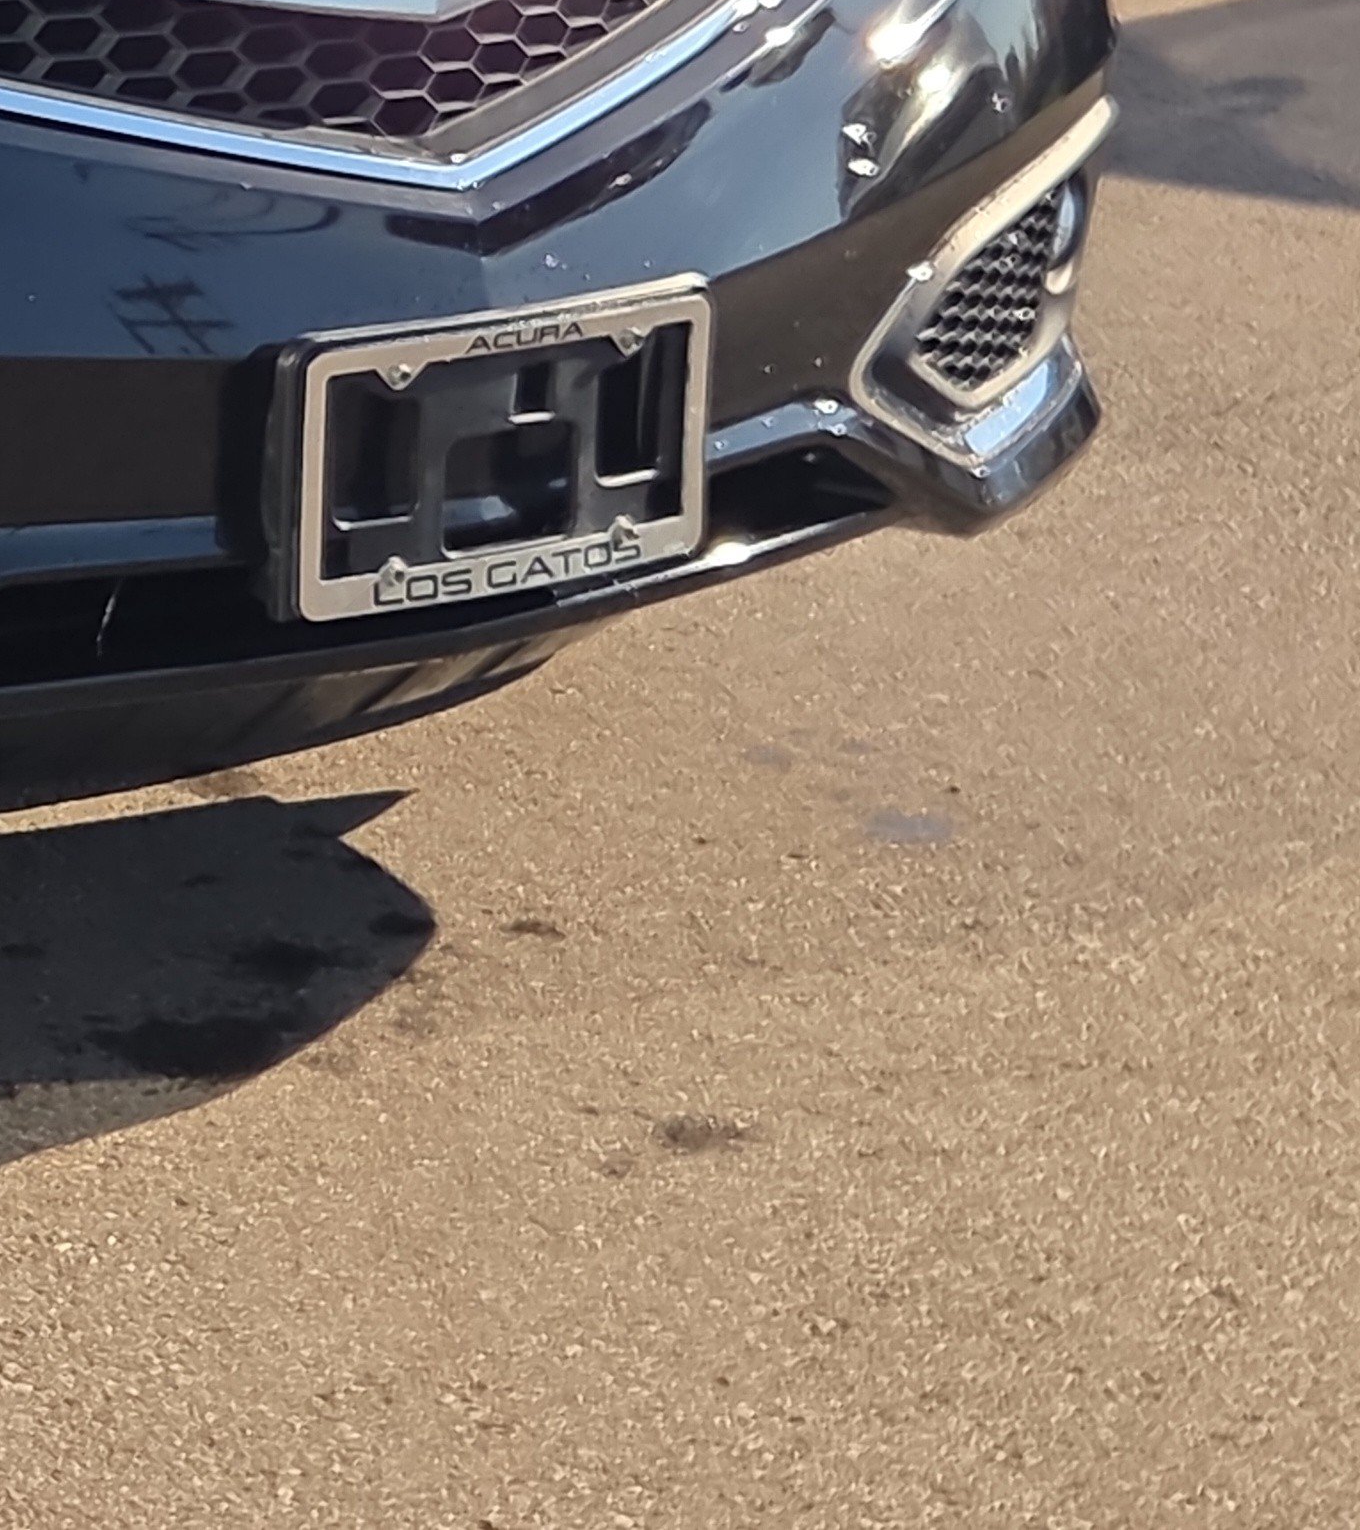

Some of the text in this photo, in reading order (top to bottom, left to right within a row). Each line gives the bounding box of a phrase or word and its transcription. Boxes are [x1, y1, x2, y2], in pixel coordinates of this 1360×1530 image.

[465, 321, 585, 355] ACURA
[373, 542, 641, 607] LOS GATOS
